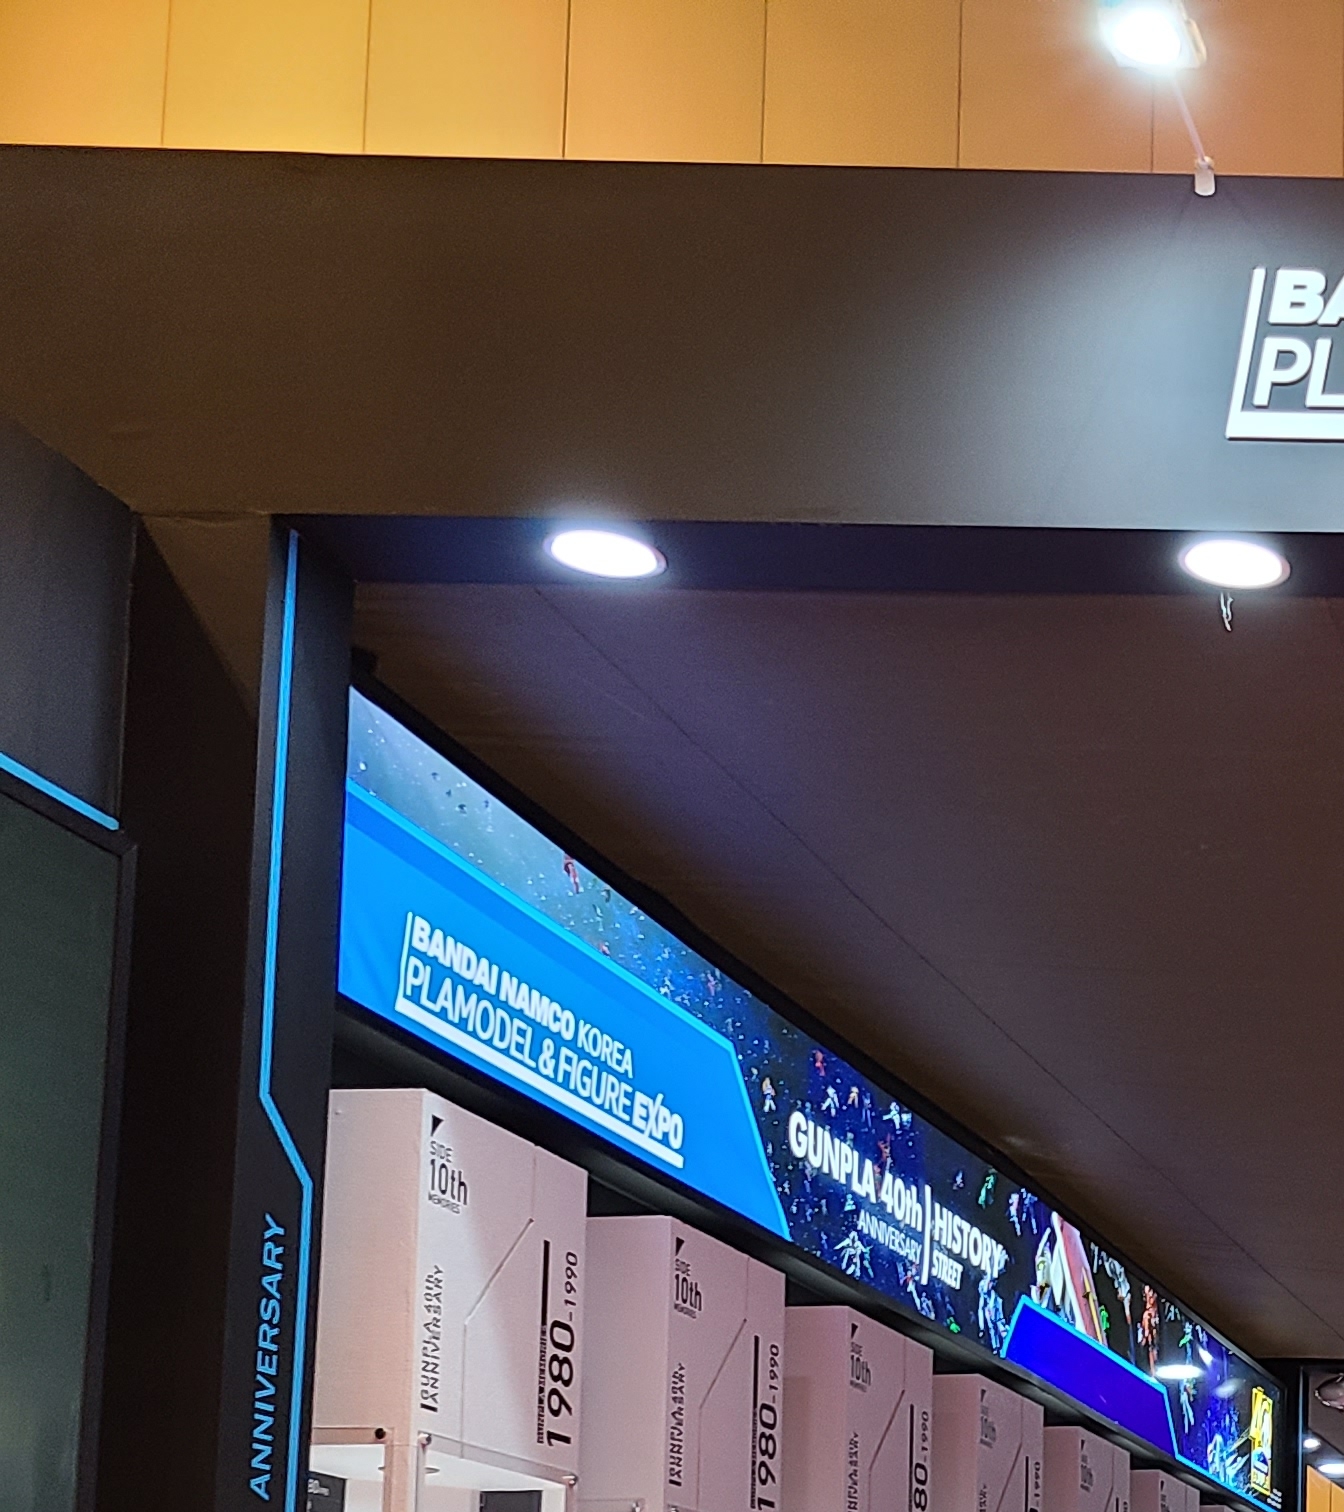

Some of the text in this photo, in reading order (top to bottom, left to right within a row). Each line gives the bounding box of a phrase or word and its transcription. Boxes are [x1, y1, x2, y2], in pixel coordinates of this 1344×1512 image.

[411, 915, 634, 1079] BANDAI NAMCO KOREA
[405, 956, 684, 1150] PLAMODEL & FIGURE EXPO
[430, 1158, 468, 1206] 10th
[788, 1111, 923, 1232] GUNPLA 40th
[857, 1209, 922, 1265] ANNIVERSARY
[931, 1249, 964, 1290] STREET
[934, 1202, 1005, 1279] HISTORY
[674, 1273, 702, 1312] 10th
[250, 1211, 288, 1502] ANNIVERSARY
